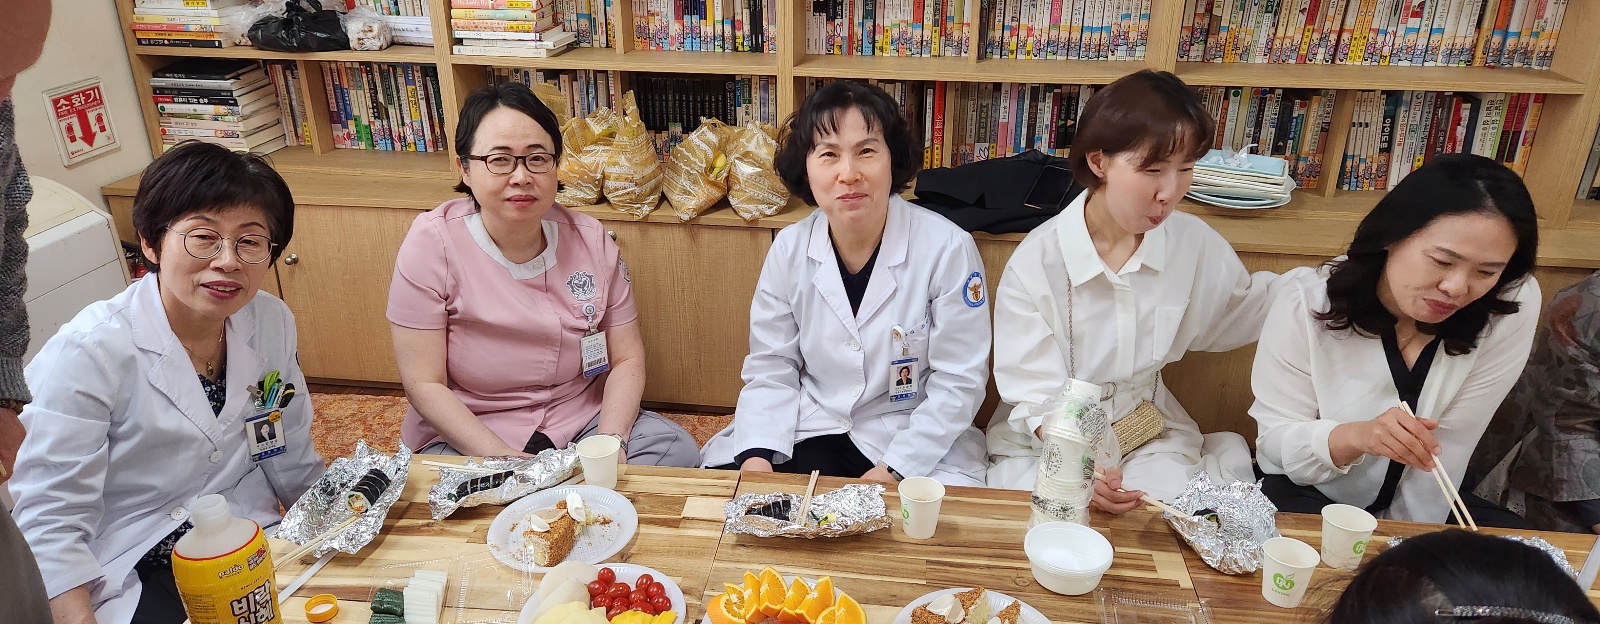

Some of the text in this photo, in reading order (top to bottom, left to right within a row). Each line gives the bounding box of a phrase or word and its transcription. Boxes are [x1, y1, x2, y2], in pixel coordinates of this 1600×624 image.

[56, 88, 100, 112] 소화기
[218, 564, 245, 579] paldo
[230, 579, 273, 616] 비락
